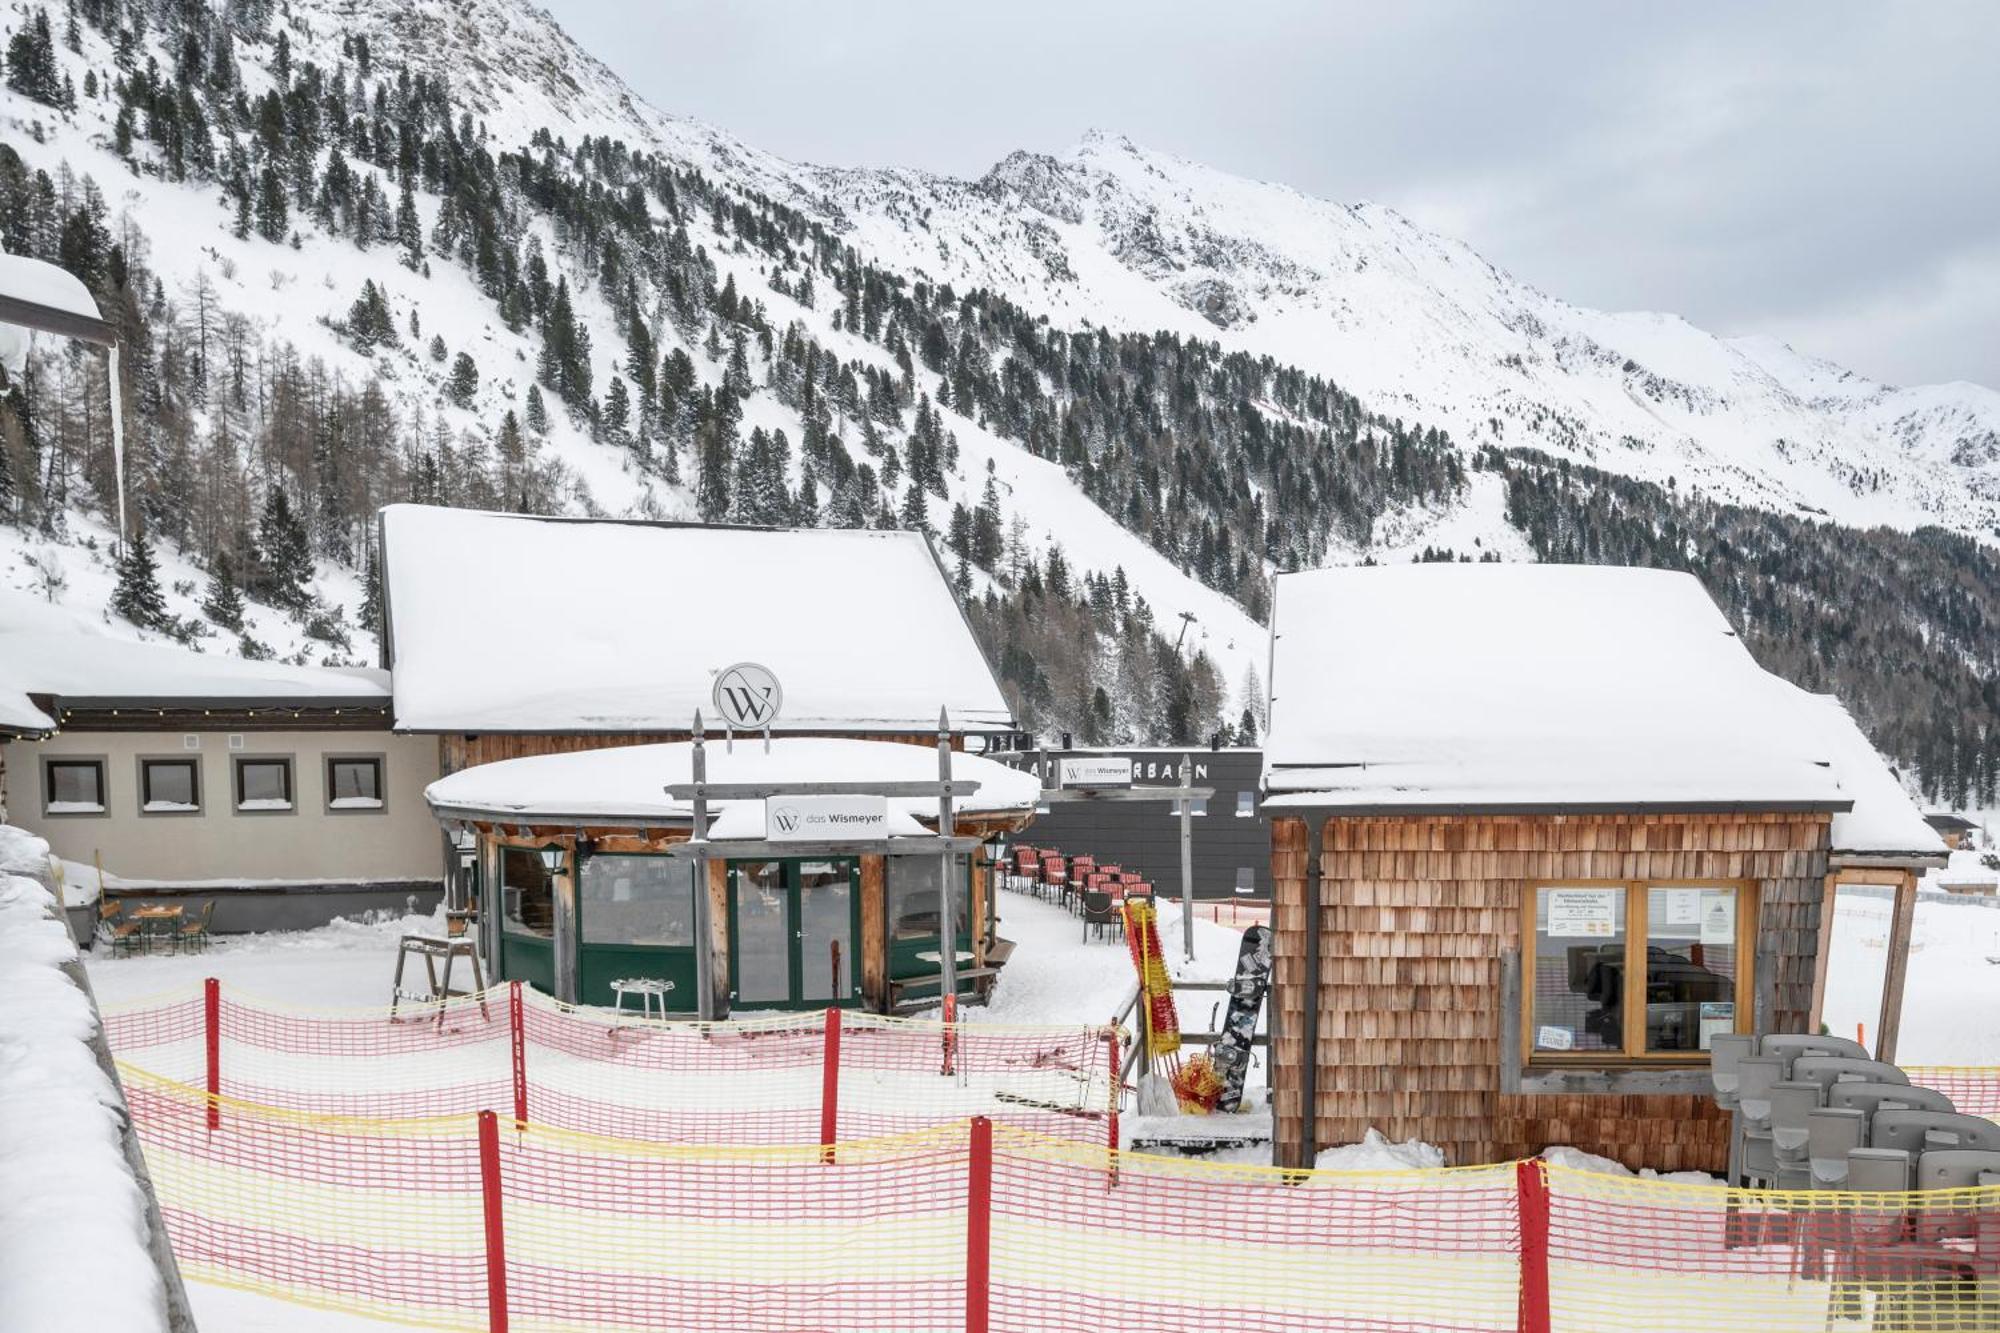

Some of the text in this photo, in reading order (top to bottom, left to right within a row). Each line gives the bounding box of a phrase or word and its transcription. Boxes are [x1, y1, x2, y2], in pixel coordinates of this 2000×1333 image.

[723, 687, 772, 722] W
[1097, 766, 1129, 776] Wismeyer
[775, 815, 799, 831] W
[806, 813, 883, 825] das Wismeyer
